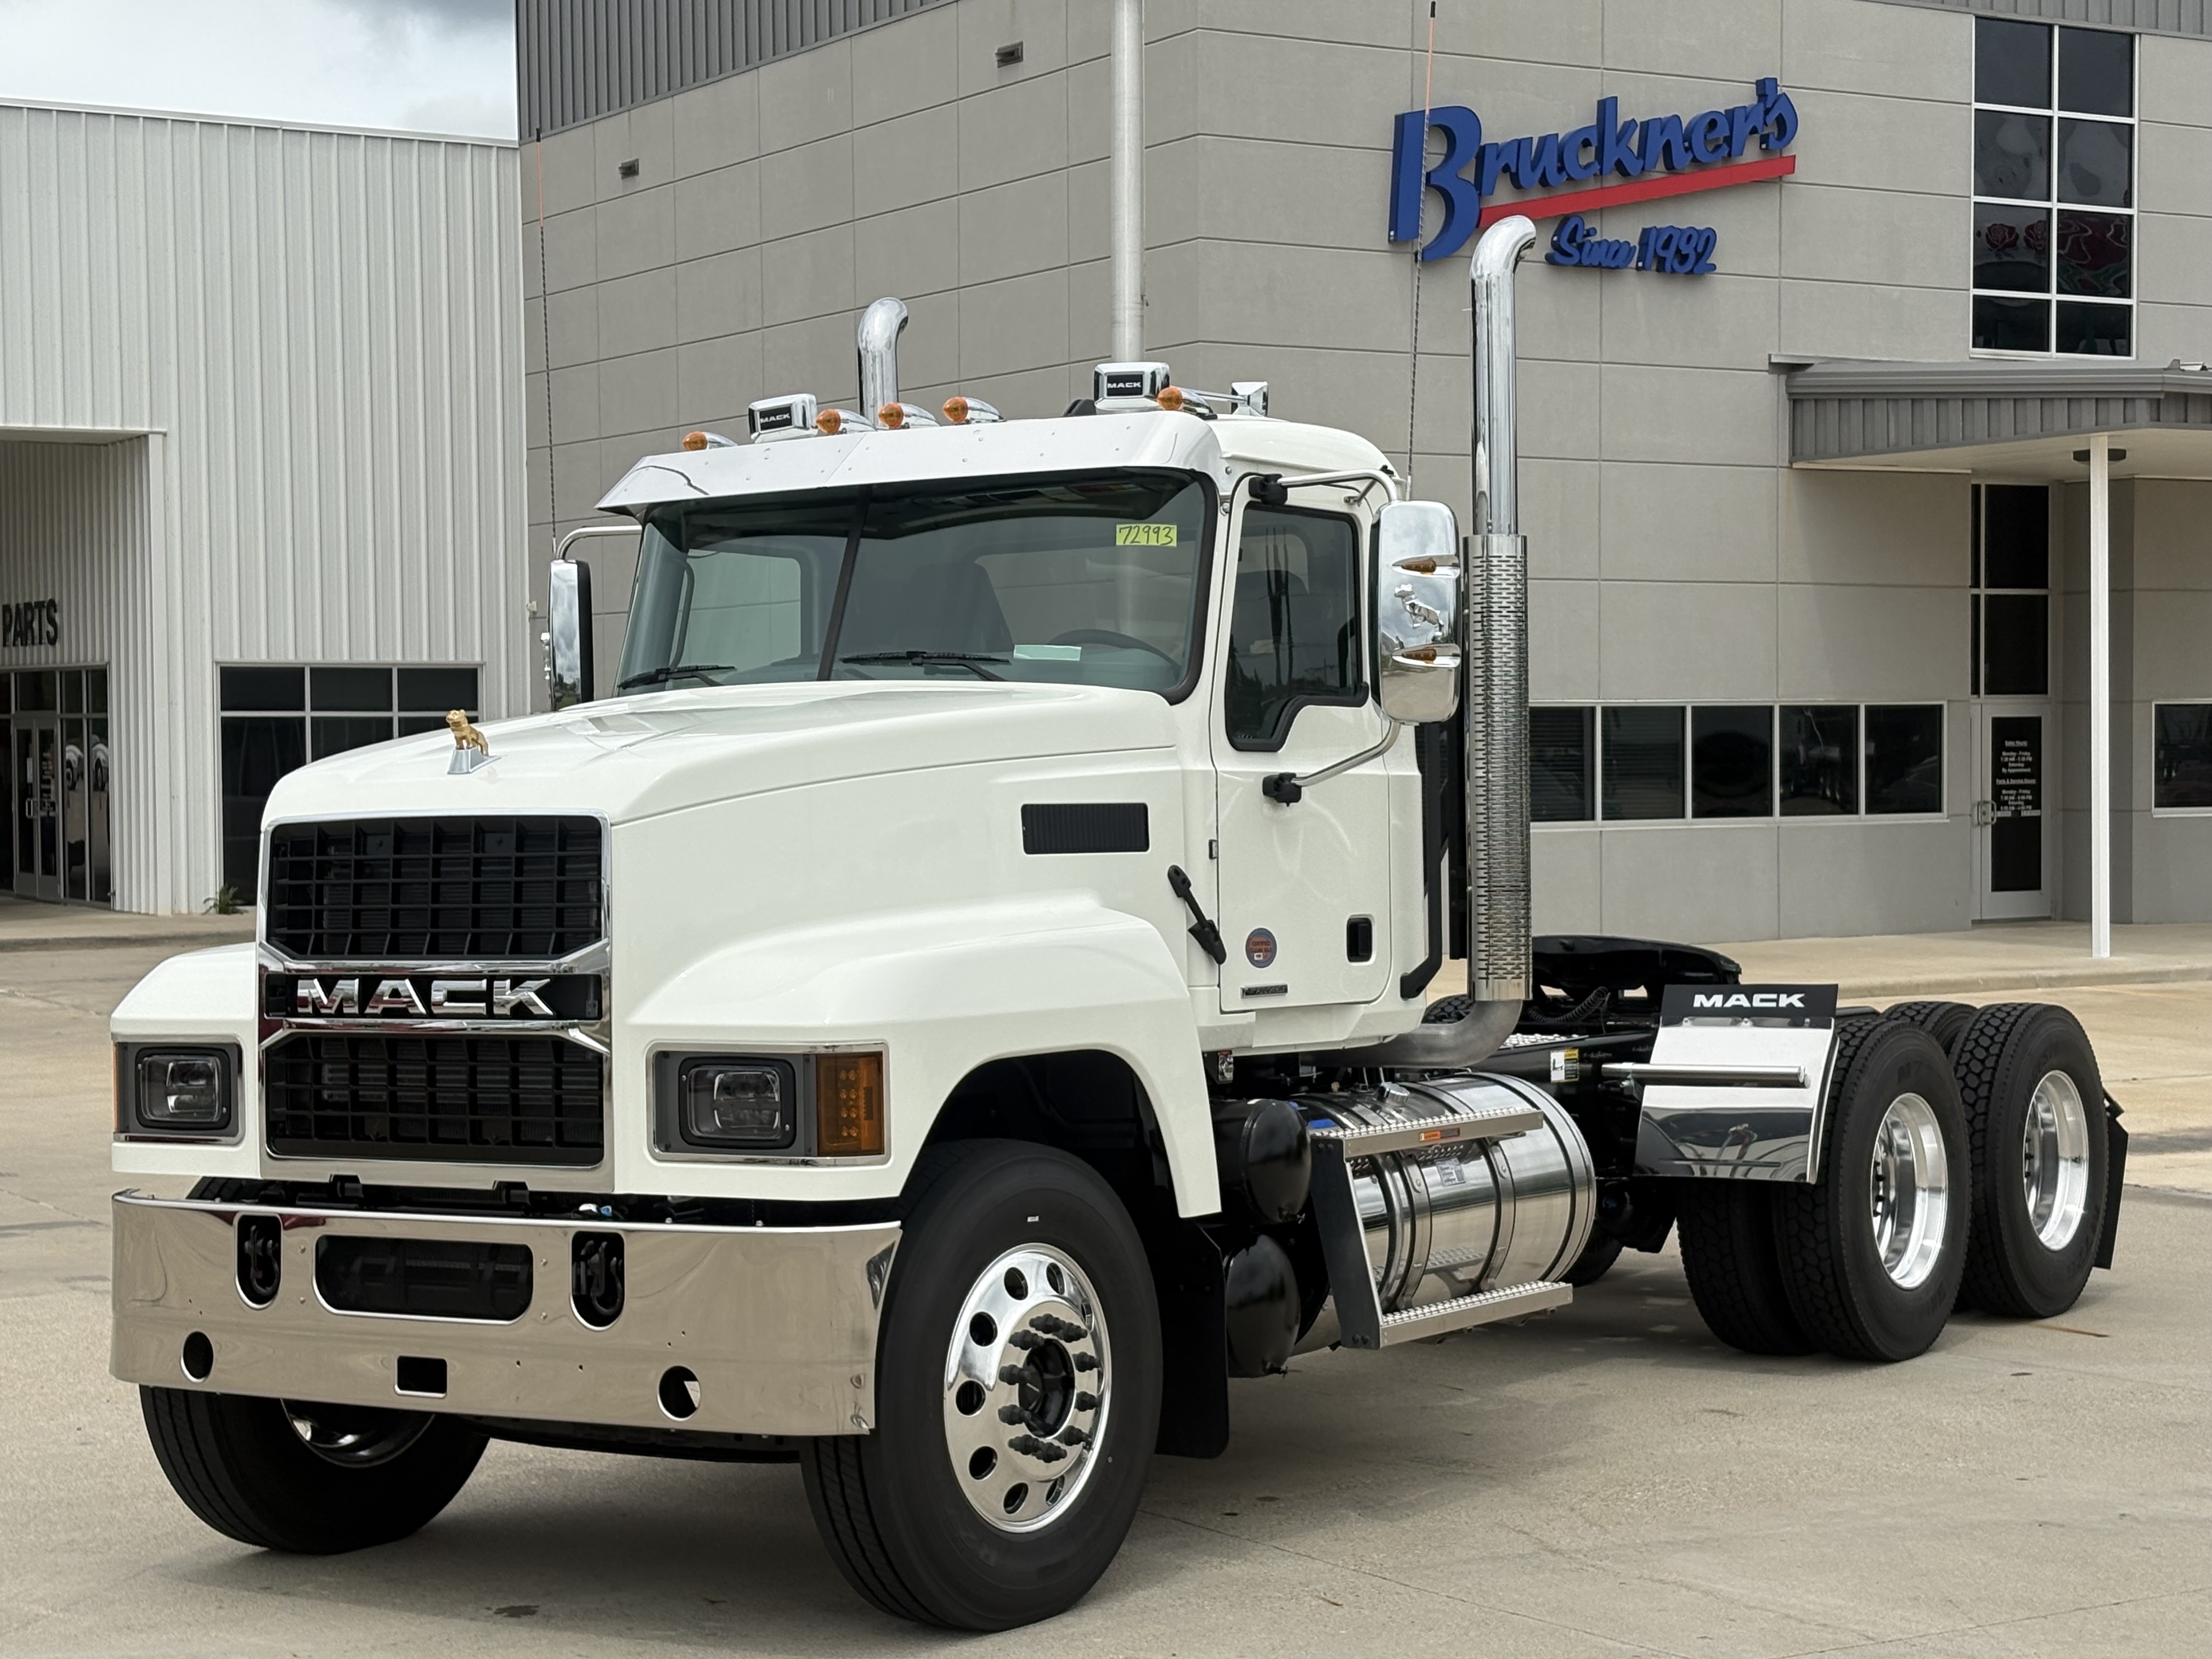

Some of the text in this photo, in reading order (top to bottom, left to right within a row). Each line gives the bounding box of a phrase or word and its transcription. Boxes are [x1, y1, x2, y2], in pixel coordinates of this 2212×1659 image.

[1389, 77, 1798, 263] Bruckner's
[1545, 216, 1717, 274] Since 1932
[759, 413, 791, 424] MACK
[1119, 525, 1173, 545] 72993
[2, 598, 58, 647] PARTS
[297, 978, 555, 1015] MACK
[1693, 994, 1805, 1008] MACK
